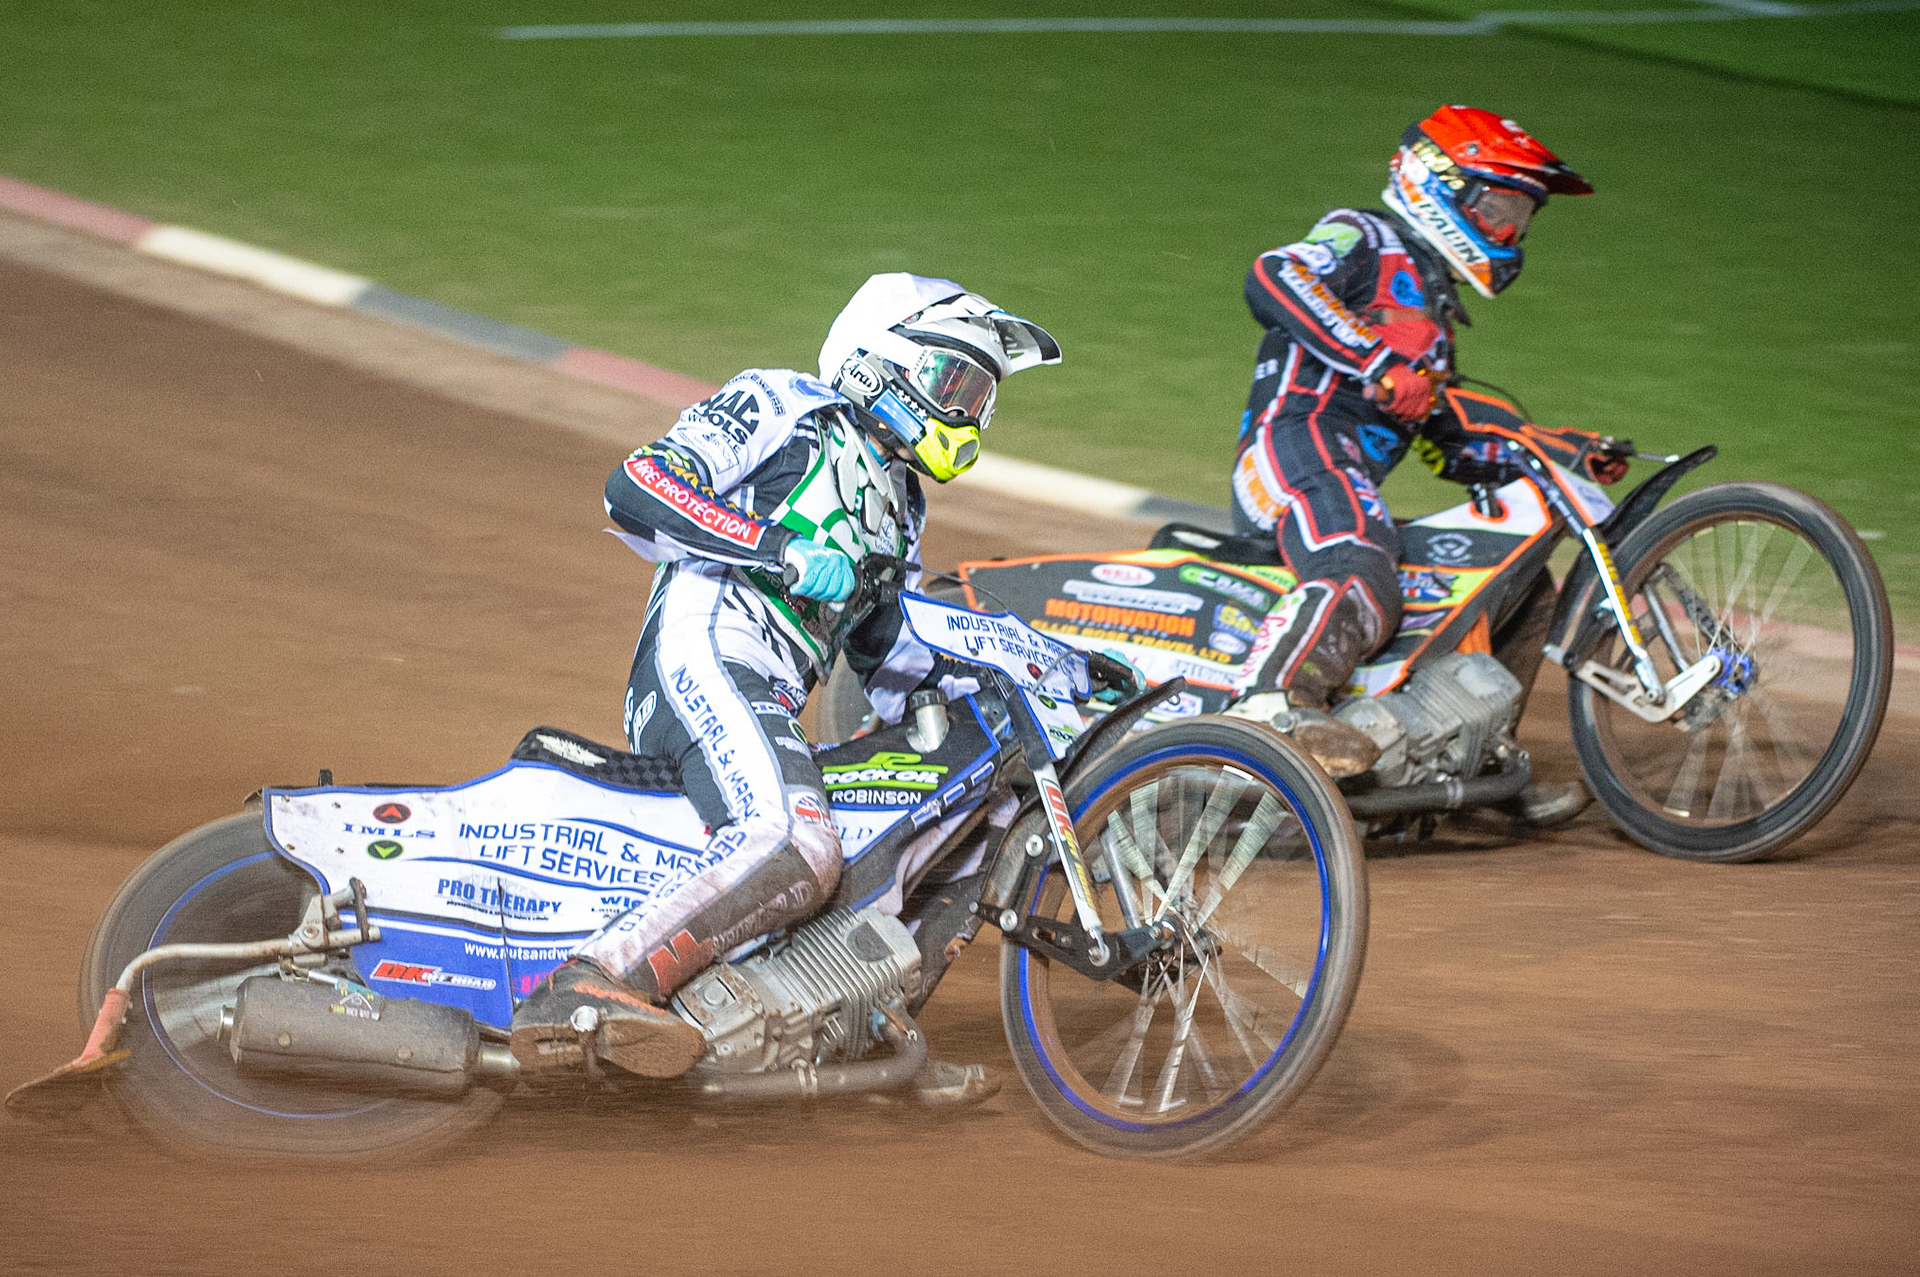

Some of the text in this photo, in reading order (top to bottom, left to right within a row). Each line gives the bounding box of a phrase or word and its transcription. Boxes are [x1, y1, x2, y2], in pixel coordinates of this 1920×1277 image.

[655, 477, 752, 540] PROTECTION
[946, 614, 1026, 644] INDUSTRIAL
[1027, 633, 1040, 649] &
[964, 635, 997, 652] LIFT
[831, 789, 922, 805] ROBINSON
[343, 822, 436, 839] IMLS
[459, 822, 608, 856] INDUSTRIAL
[620, 842, 641, 864] &
[480, 844, 666, 888] LIFT SERVICES
[437, 878, 476, 900] PRO
[480, 886, 563, 913] THERAPY
